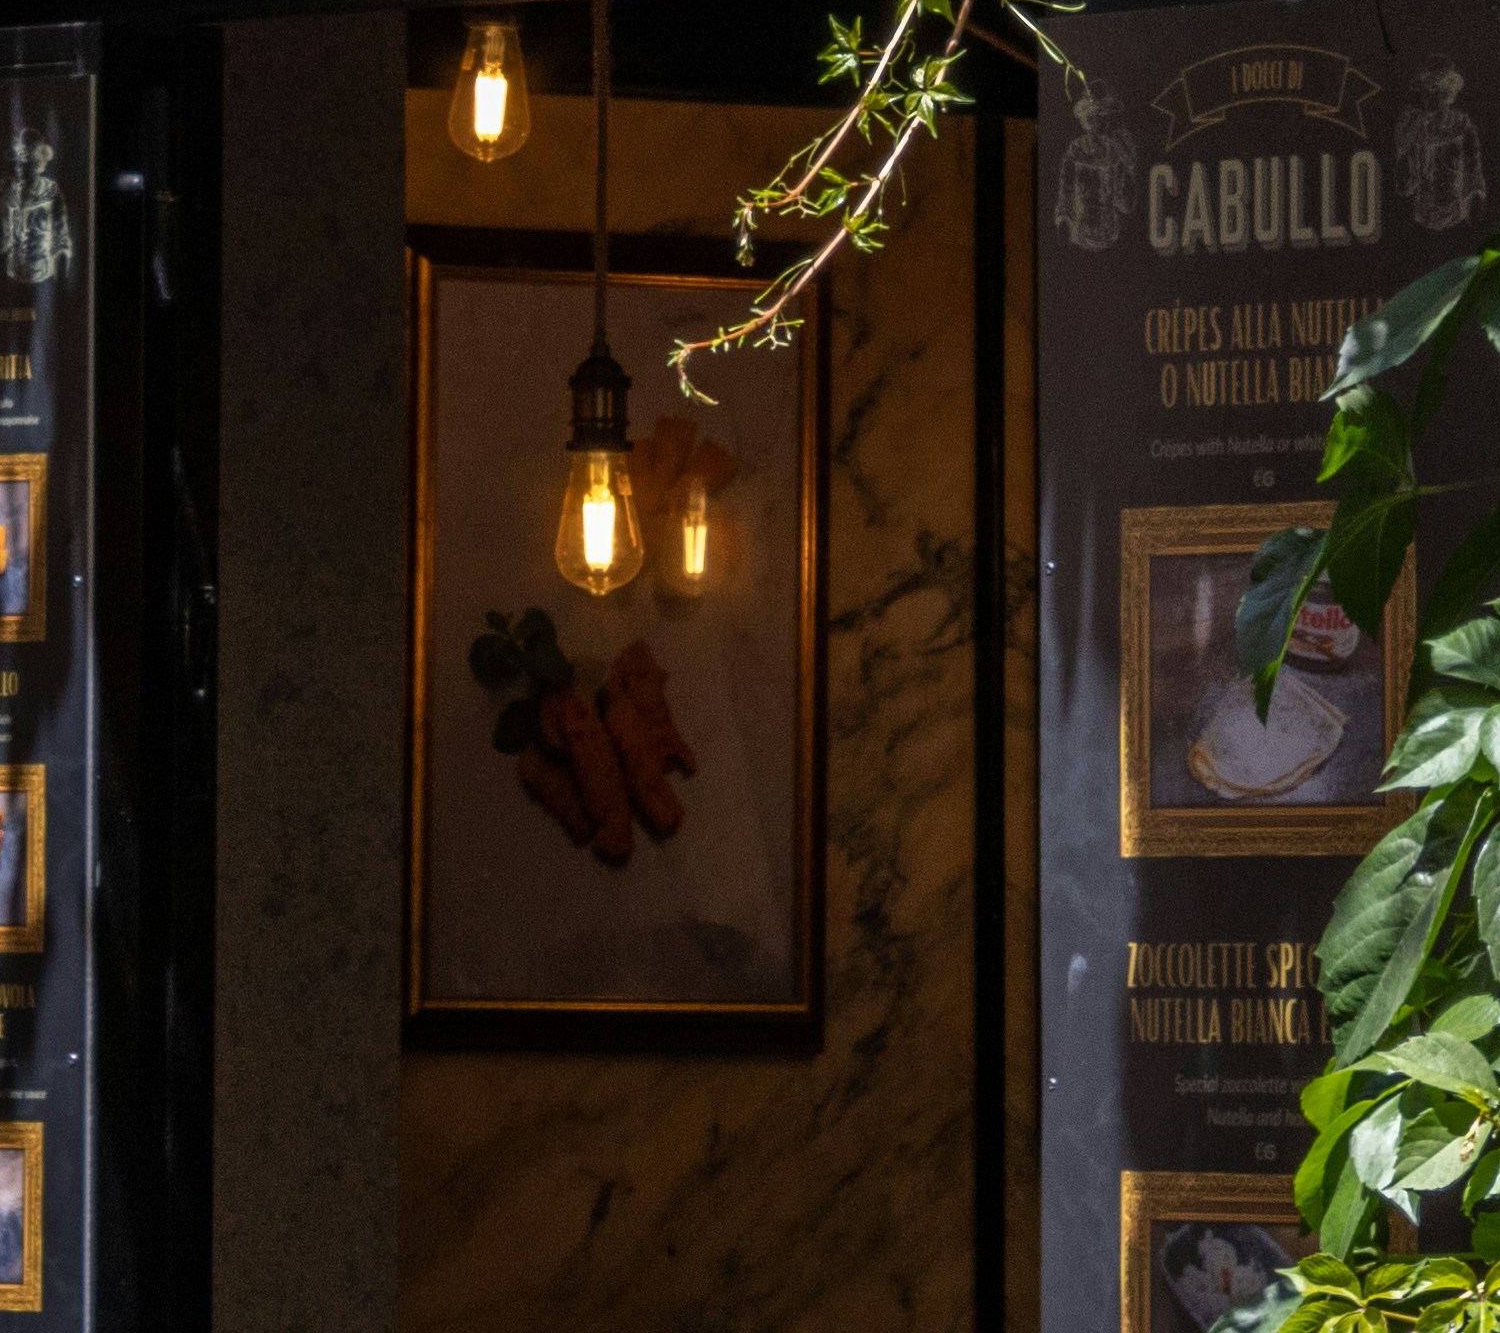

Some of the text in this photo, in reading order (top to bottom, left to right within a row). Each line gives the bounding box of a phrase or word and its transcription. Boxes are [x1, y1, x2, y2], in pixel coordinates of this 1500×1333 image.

[1242, 60, 1285, 92] DOLCI
[1288, 59, 1304, 90] DI
[1148, 150, 1382, 255] CABULLO
[1231, 302, 1282, 350] ALLA
[1160, 363, 1179, 408] O
[1186, 358, 1280, 407] NUTELLA
[1228, 434, 1275, 454] Nutella
[1253, 468, 1276, 488] €6
[1126, 940, 1259, 990] ZOCCOLETTE
[1129, 996, 1223, 1046] NUTELLA
[1230, 996, 1313, 1046] BIANCA
[1254, 1140, 1278, 1161] €6
